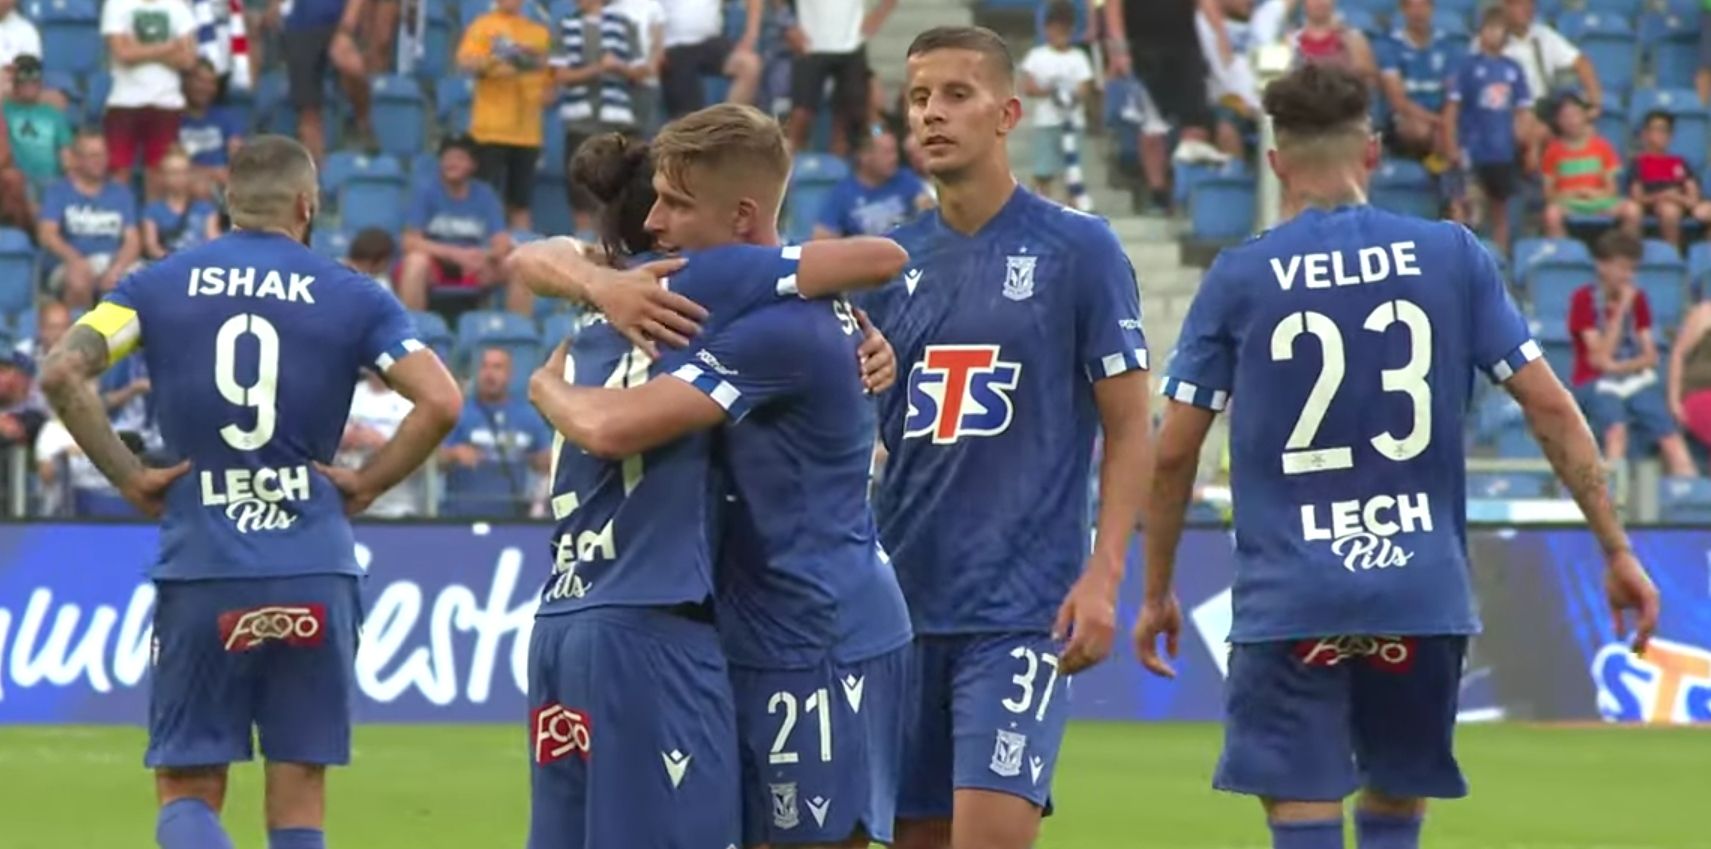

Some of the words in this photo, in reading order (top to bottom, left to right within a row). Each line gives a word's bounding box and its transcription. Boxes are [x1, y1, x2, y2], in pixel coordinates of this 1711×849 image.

[187, 266, 316, 304] ISHAK
[1269, 240, 1422, 290] VELDE
[214, 312, 281, 451] 9
[903, 344, 1022, 444] STS
[1270, 299, 1433, 475] 23
[200, 465, 311, 506] LECH
[225, 497, 298, 534] Pils
[1300, 492, 1434, 541] LECH
[1331, 531, 1415, 573] Pils
[1001, 646, 1060, 722] 37
[767, 688, 832, 764] 21
